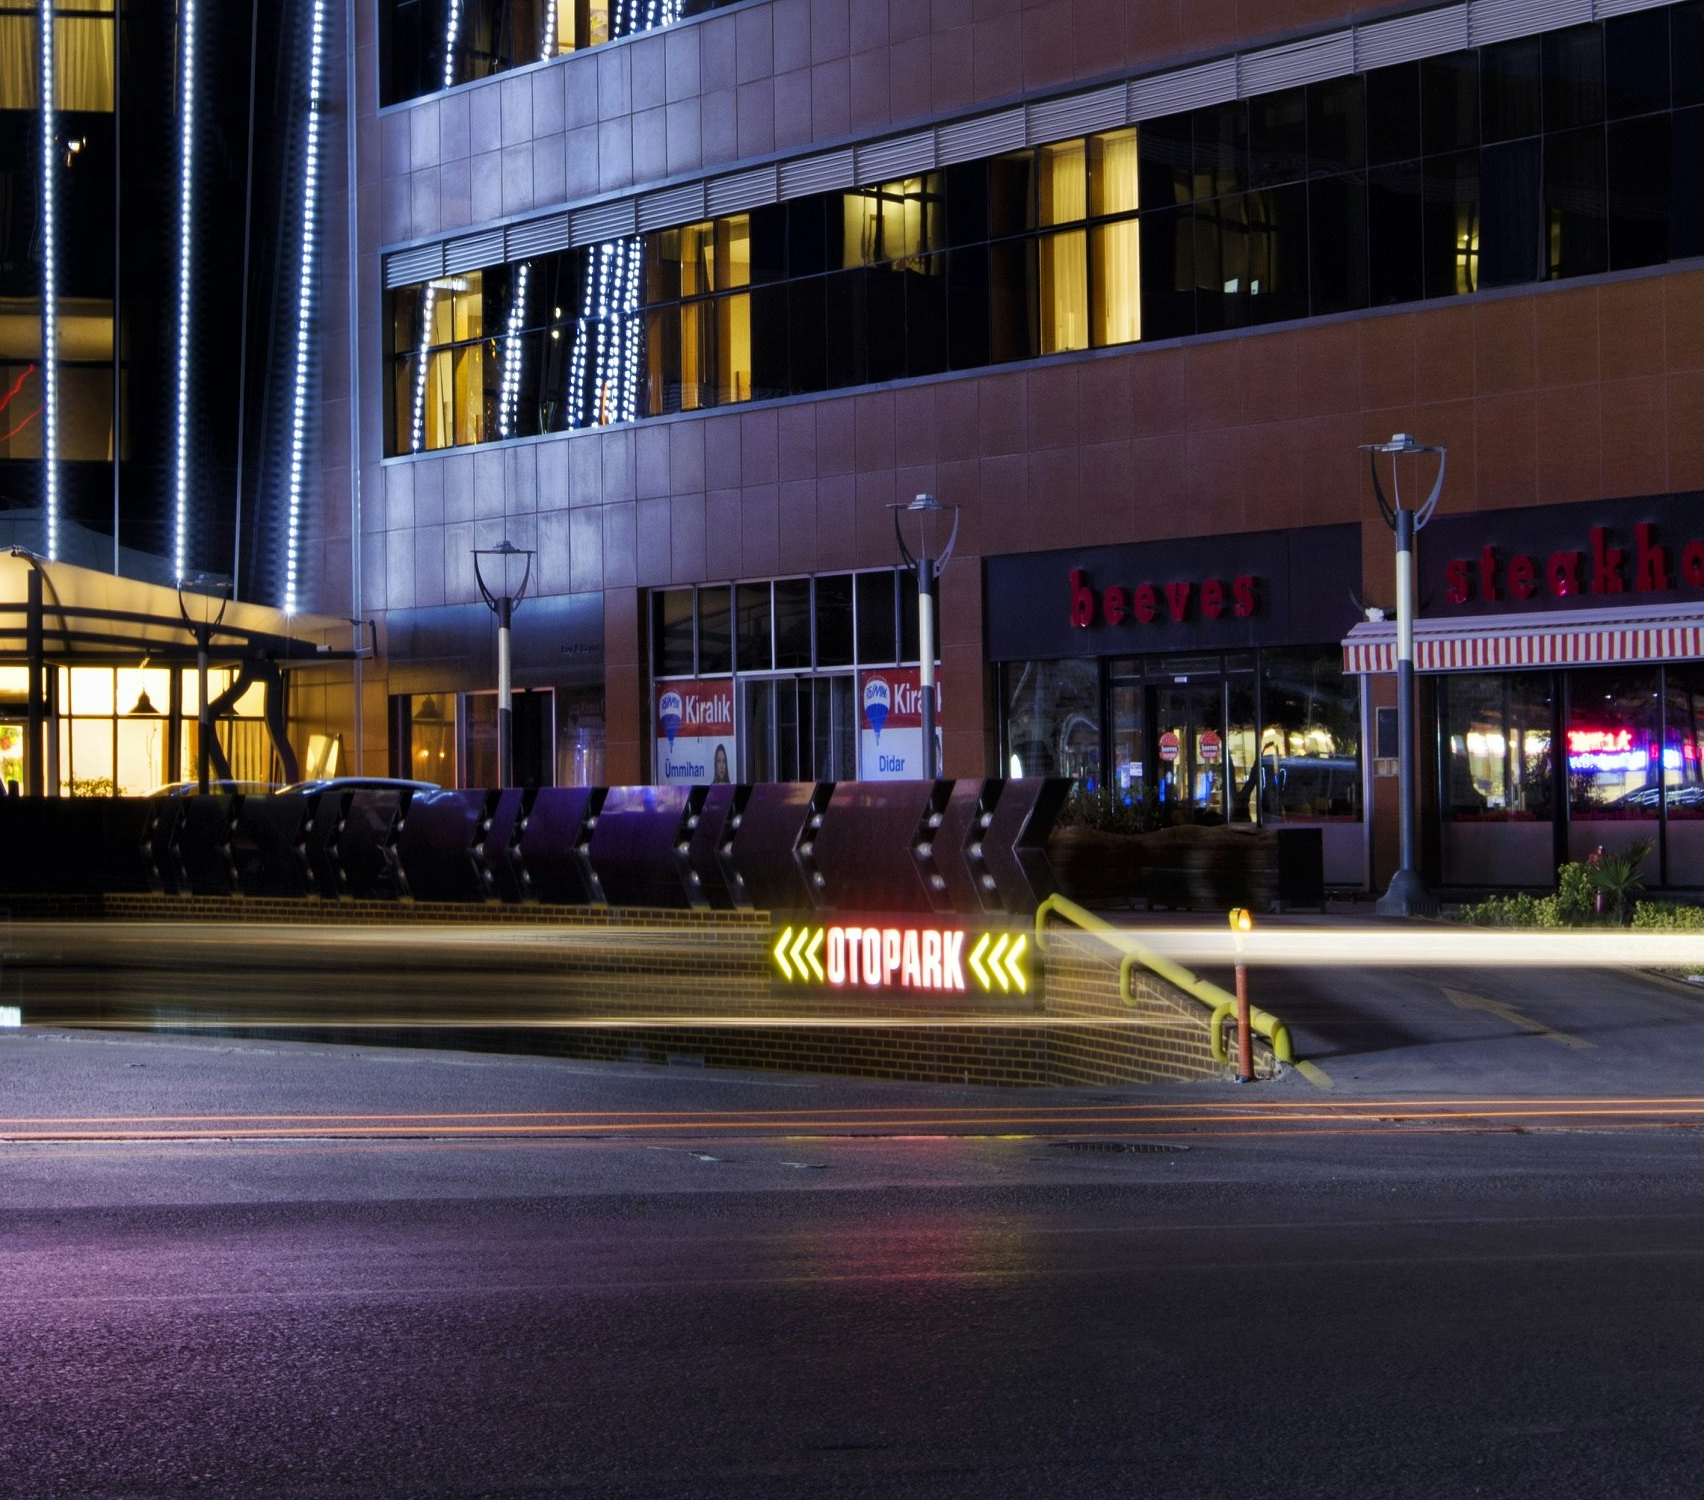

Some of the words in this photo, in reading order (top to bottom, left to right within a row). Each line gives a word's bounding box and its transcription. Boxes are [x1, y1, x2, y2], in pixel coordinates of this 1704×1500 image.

[1069, 568, 1256, 628] beeves
[685, 694, 731, 724] Kiralık
[665, 758, 705, 778] Ümmihan
[879, 755, 905, 772] Didar
[827, 927, 965, 989] OTOPARK
